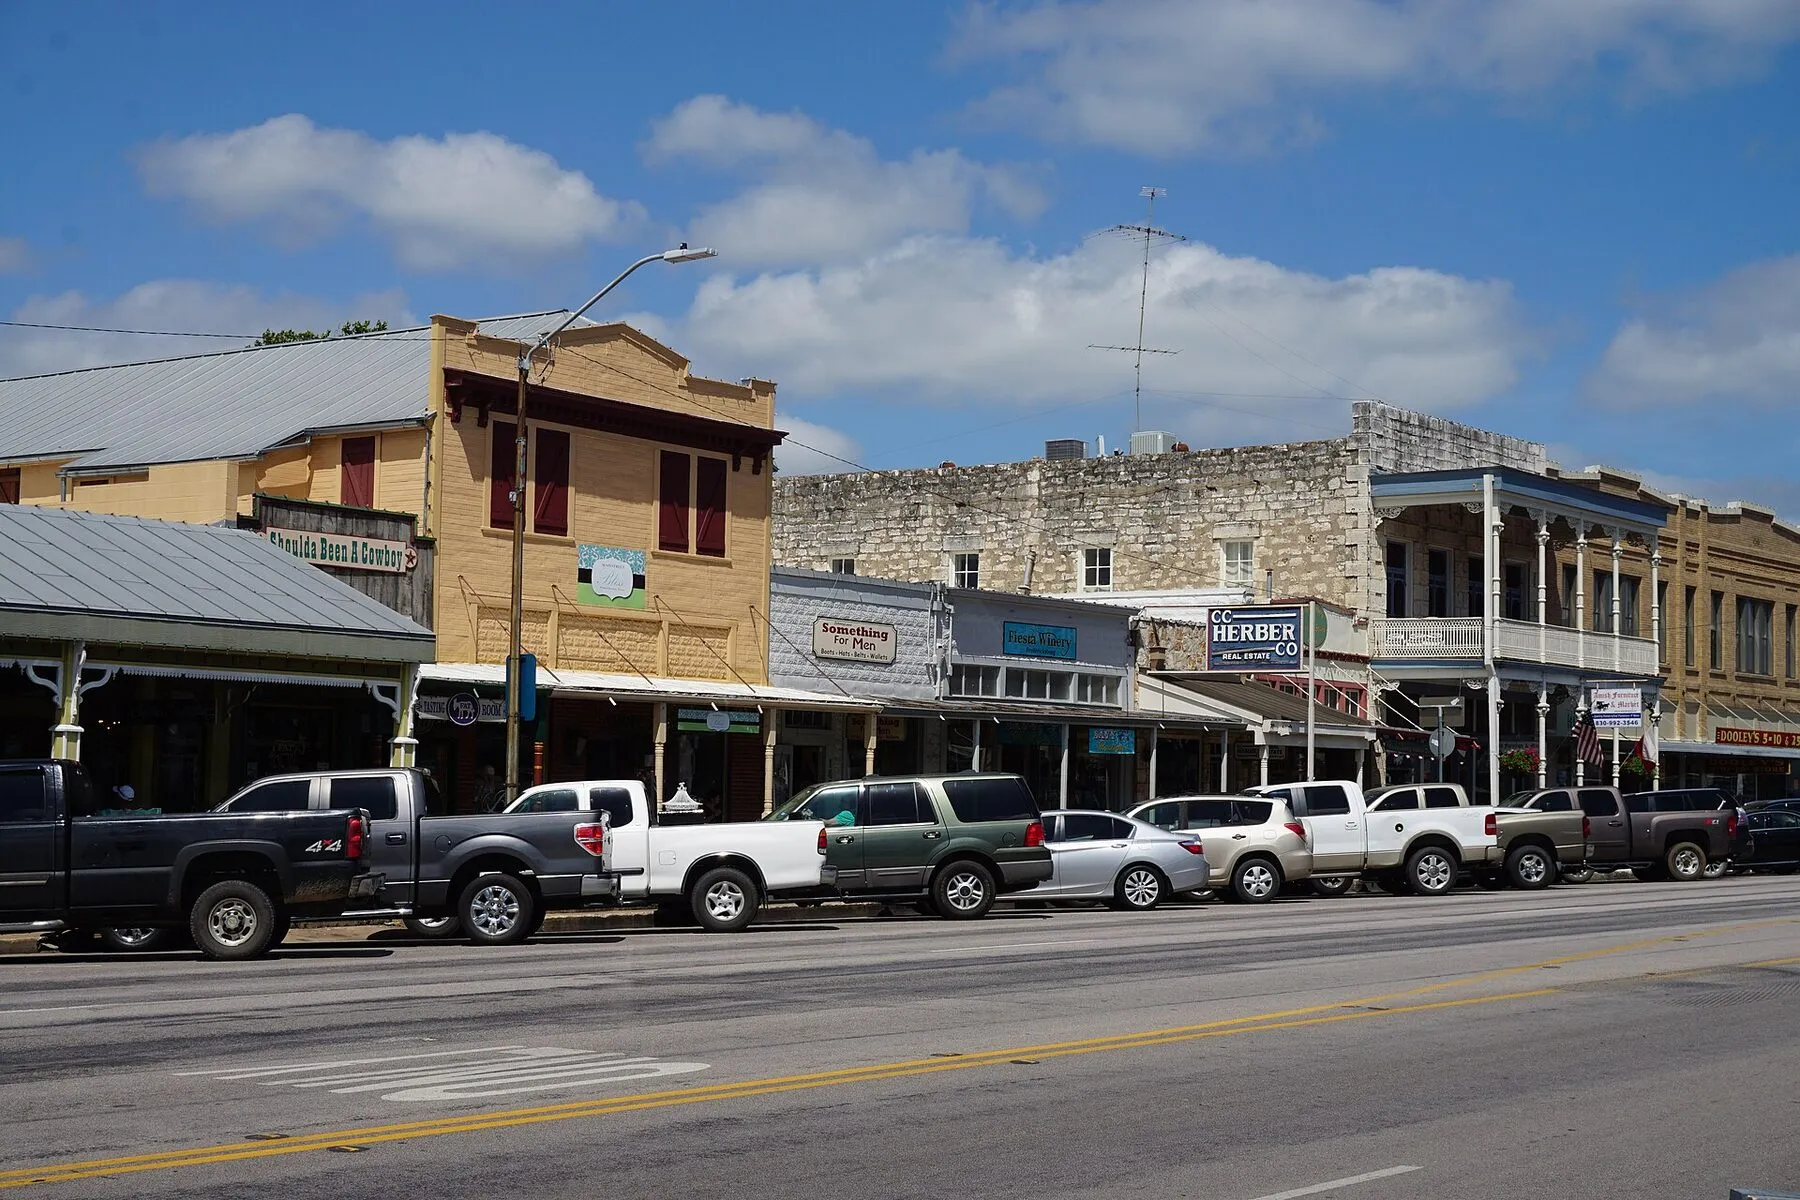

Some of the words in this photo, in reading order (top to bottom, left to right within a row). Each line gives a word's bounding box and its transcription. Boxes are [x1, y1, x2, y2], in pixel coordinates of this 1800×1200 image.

[320, 537, 348, 561] Been
[351, 541, 358, 563] A
[361, 541, 403, 571] Cowboy
[1211, 609, 1232, 624] CC
[822, 622, 889, 642] Something
[1212, 623, 1296, 642] HERBER
[834, 635, 849, 645] For
[852, 637, 876, 651] Men
[1008, 630, 1036, 645] Fiesta
[1039, 631, 1072, 656] Winery
[1275, 641, 1298, 656] CO
[820, 647, 835, 656] Boots
[854, 651, 866, 659] Belts
[1222, 652, 1242, 660] REAL
[1244, 652, 1271, 660] ESTATE
[1720, 730, 1760, 743] DOOLEY'S
